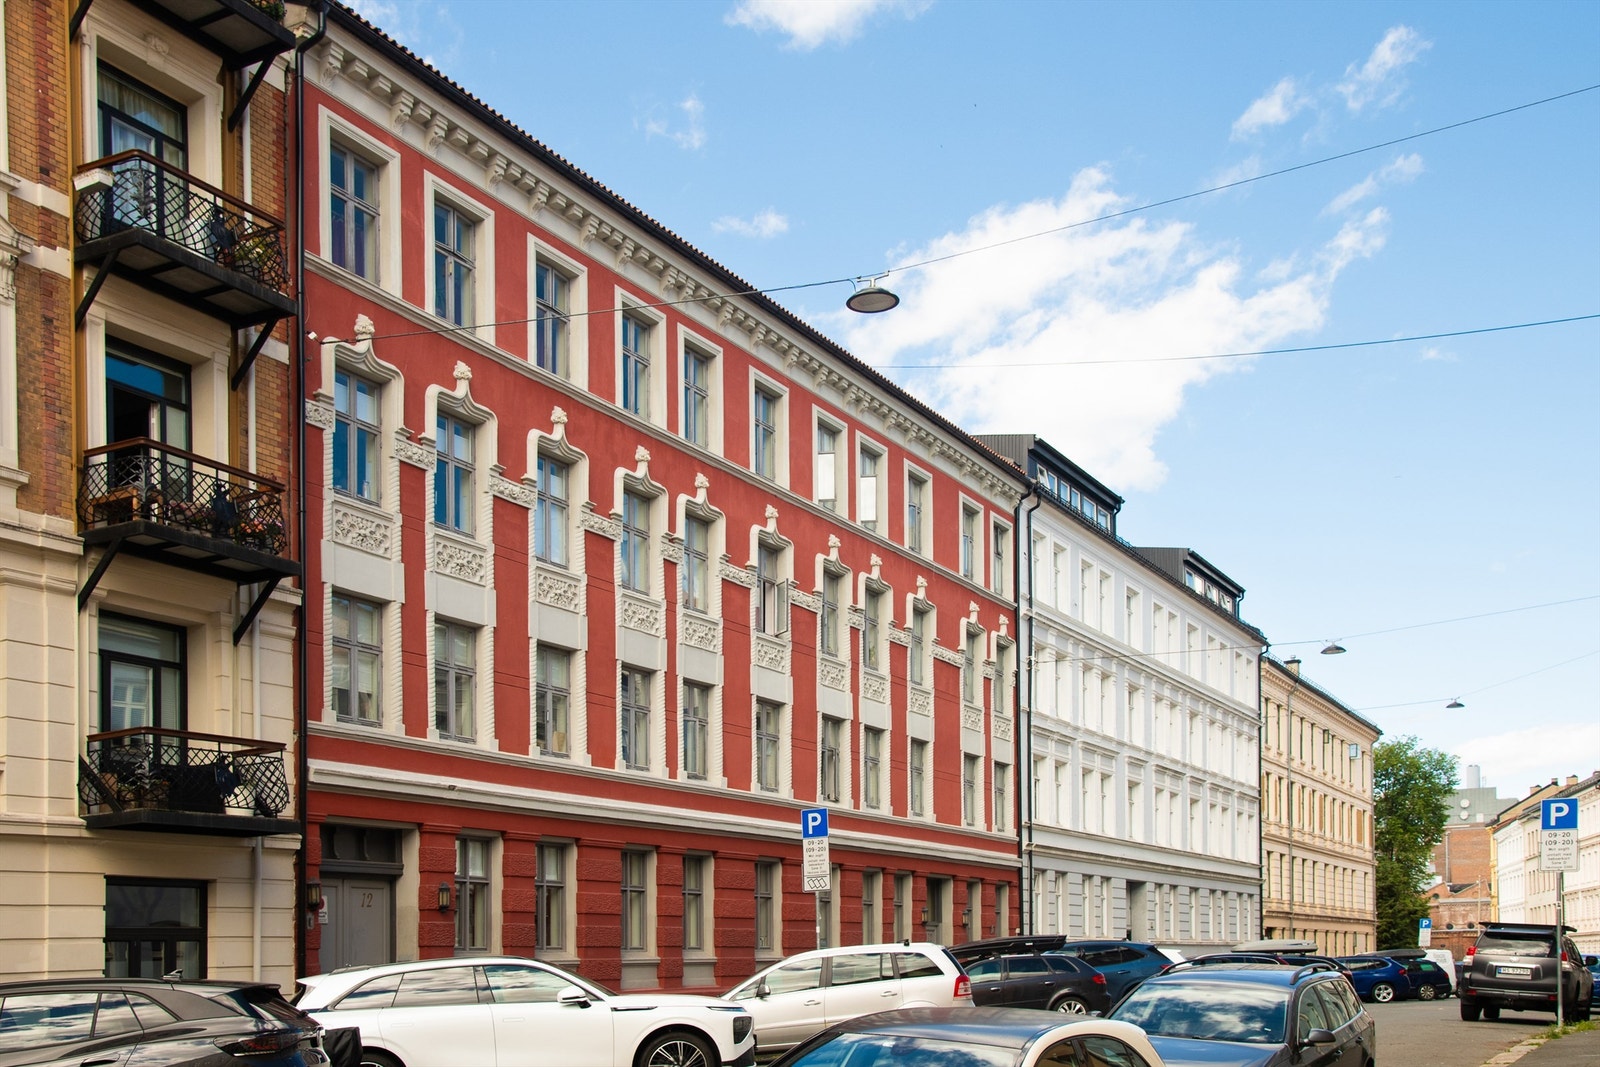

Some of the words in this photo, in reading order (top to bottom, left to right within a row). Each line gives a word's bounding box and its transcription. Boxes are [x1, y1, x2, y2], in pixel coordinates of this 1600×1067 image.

[808, 812, 822, 834] P
[1550, 802, 1569, 826] P
[361, 892, 373, 908] 12
